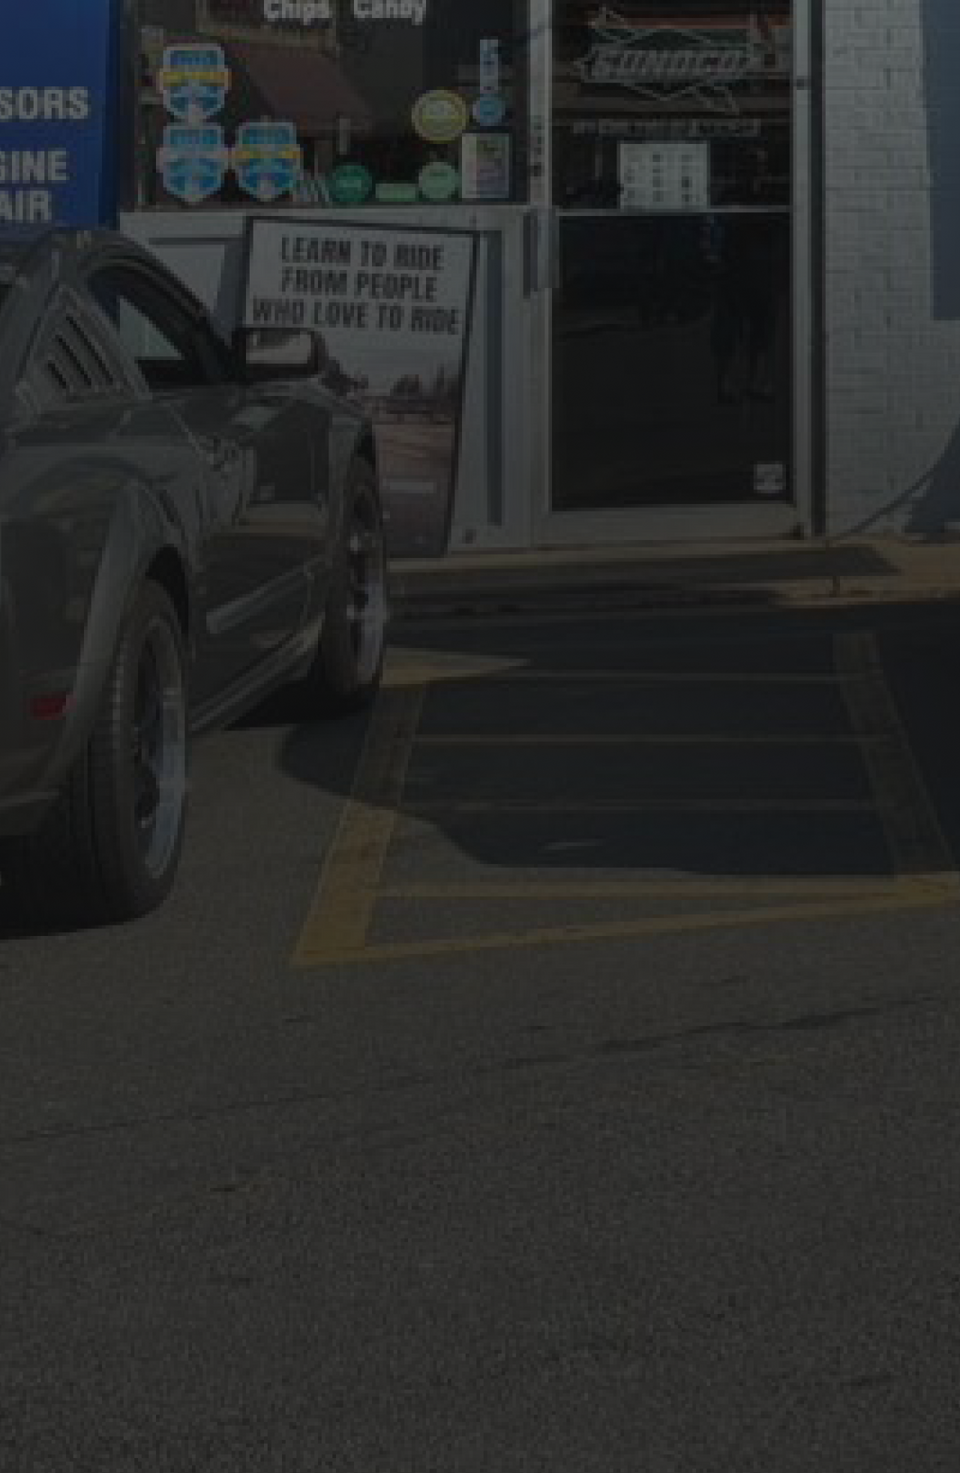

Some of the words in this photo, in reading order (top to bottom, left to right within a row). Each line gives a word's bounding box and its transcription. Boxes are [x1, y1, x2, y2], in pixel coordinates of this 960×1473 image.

[279, 236, 350, 263] LEARN
[360, 240, 387, 267] TO
[393, 244, 444, 270] RIDE
[280, 266, 348, 296] FROM
[355, 270, 438, 302] PEOPLE
[252, 296, 305, 326] WHO
[313, 301, 369, 329] LOVE
[377, 305, 404, 331] TO
[410, 309, 459, 335] RIDE
